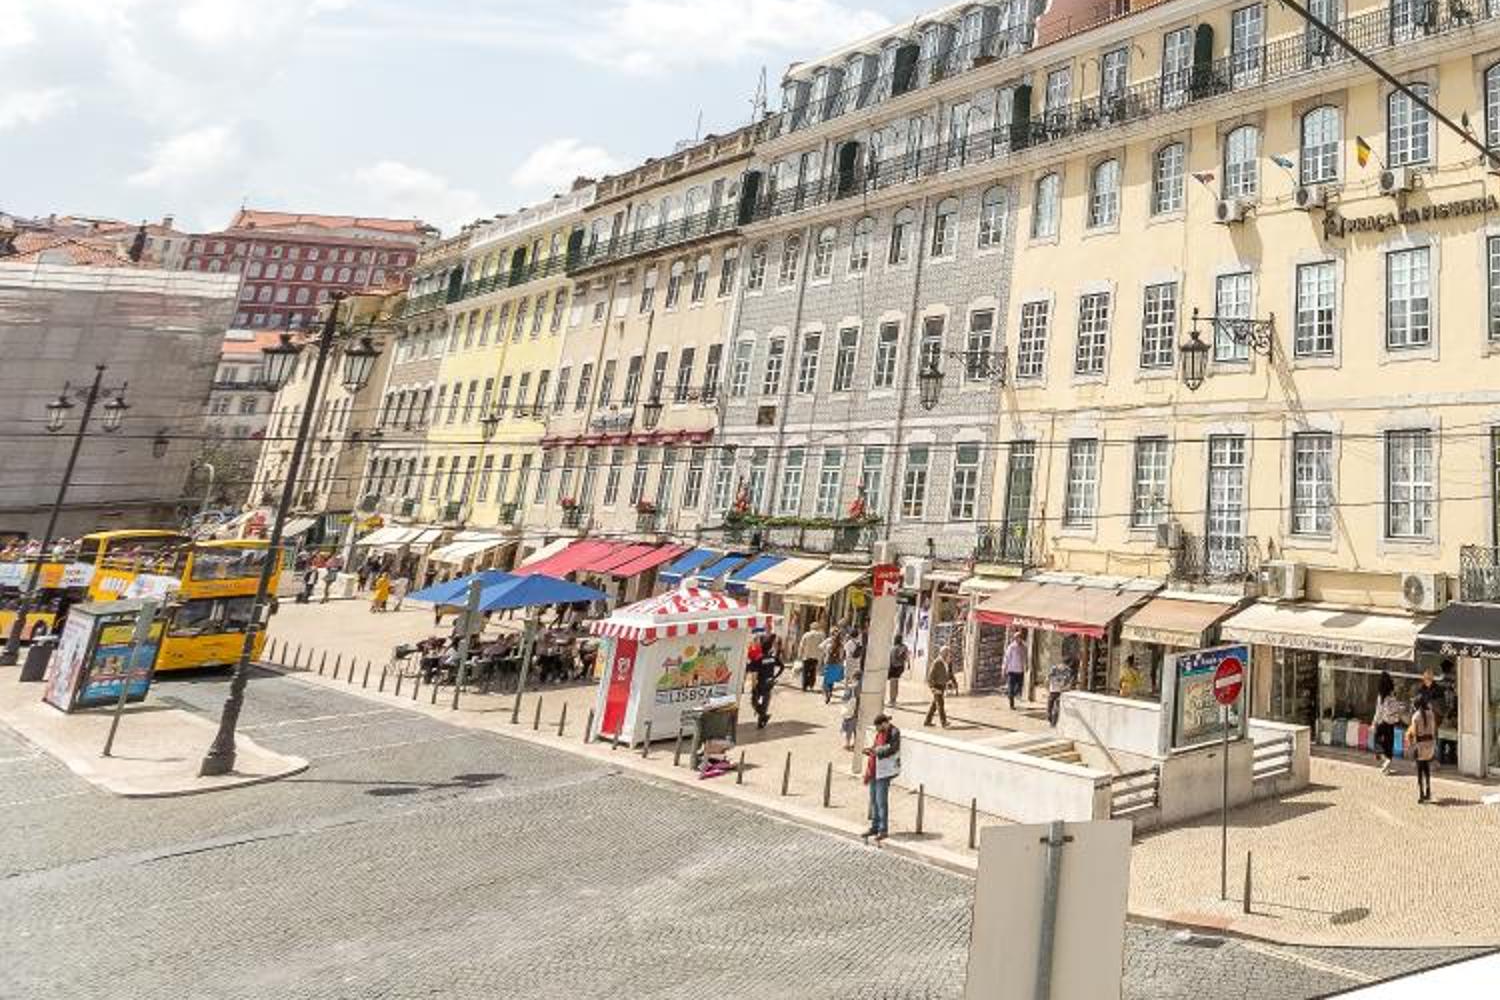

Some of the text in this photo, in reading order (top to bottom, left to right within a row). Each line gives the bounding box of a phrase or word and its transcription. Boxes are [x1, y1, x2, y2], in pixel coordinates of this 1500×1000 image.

[1344, 193, 1500, 233] PRAÇA DA FIGUEIRA
